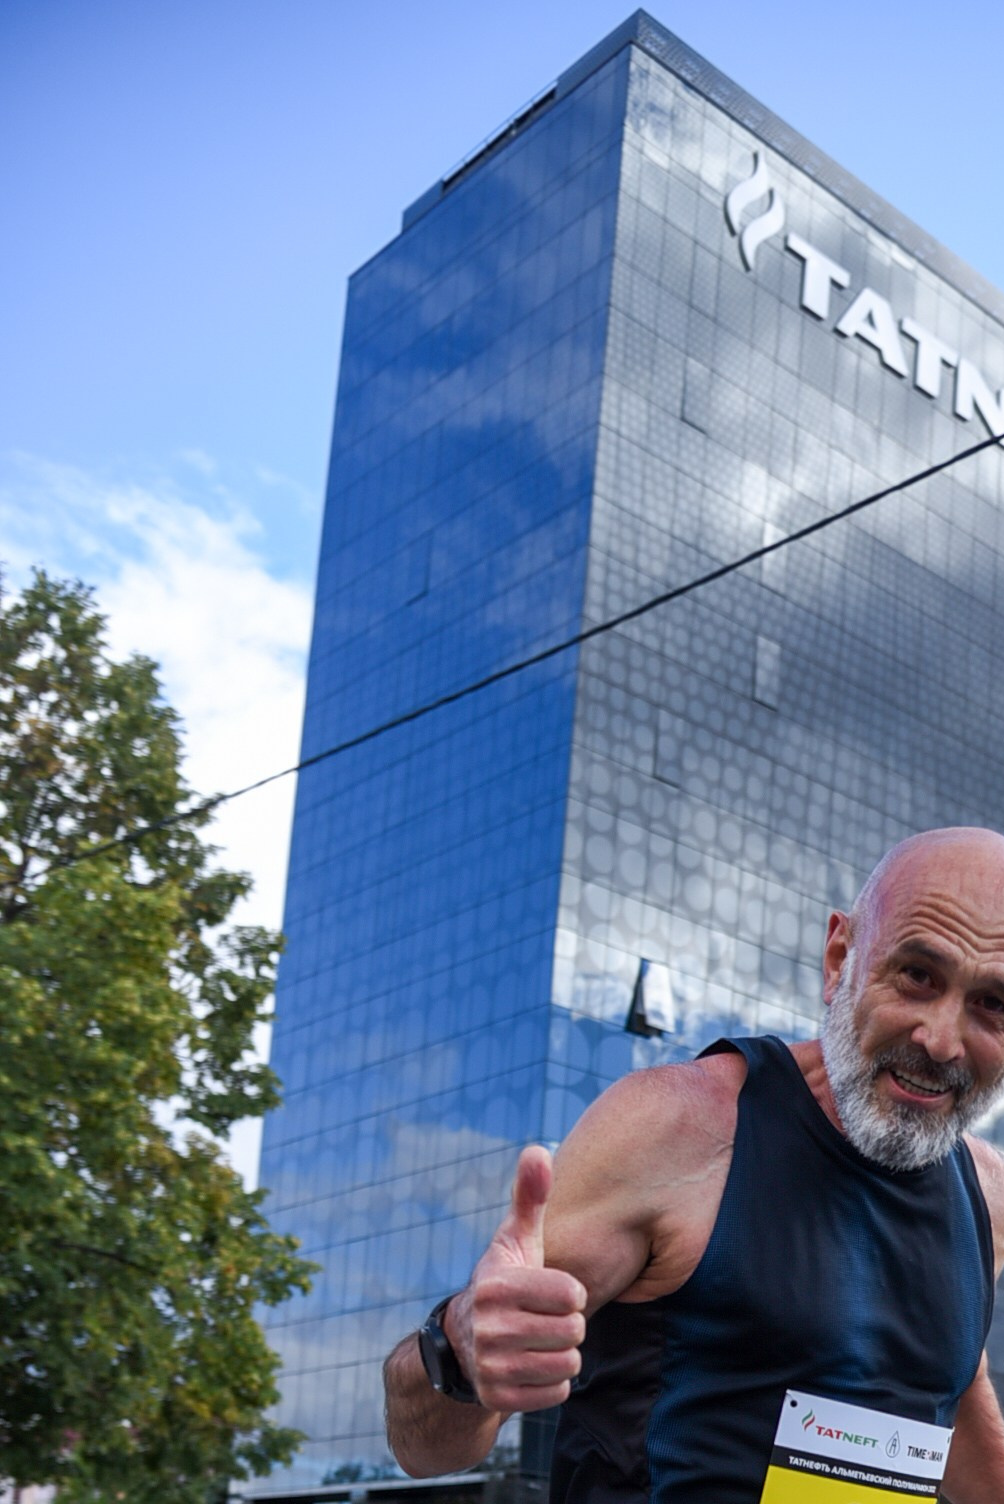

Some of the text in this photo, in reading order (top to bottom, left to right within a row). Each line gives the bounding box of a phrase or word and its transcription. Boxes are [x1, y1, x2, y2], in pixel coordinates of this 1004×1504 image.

[816, 1425, 879, 1448] TATNEFT
[788, 1455, 831, 1473] ТАТНЕФТЬ
[831, 1466, 892, 1486] АЛЬМЕТЬЕВСКИЙ
